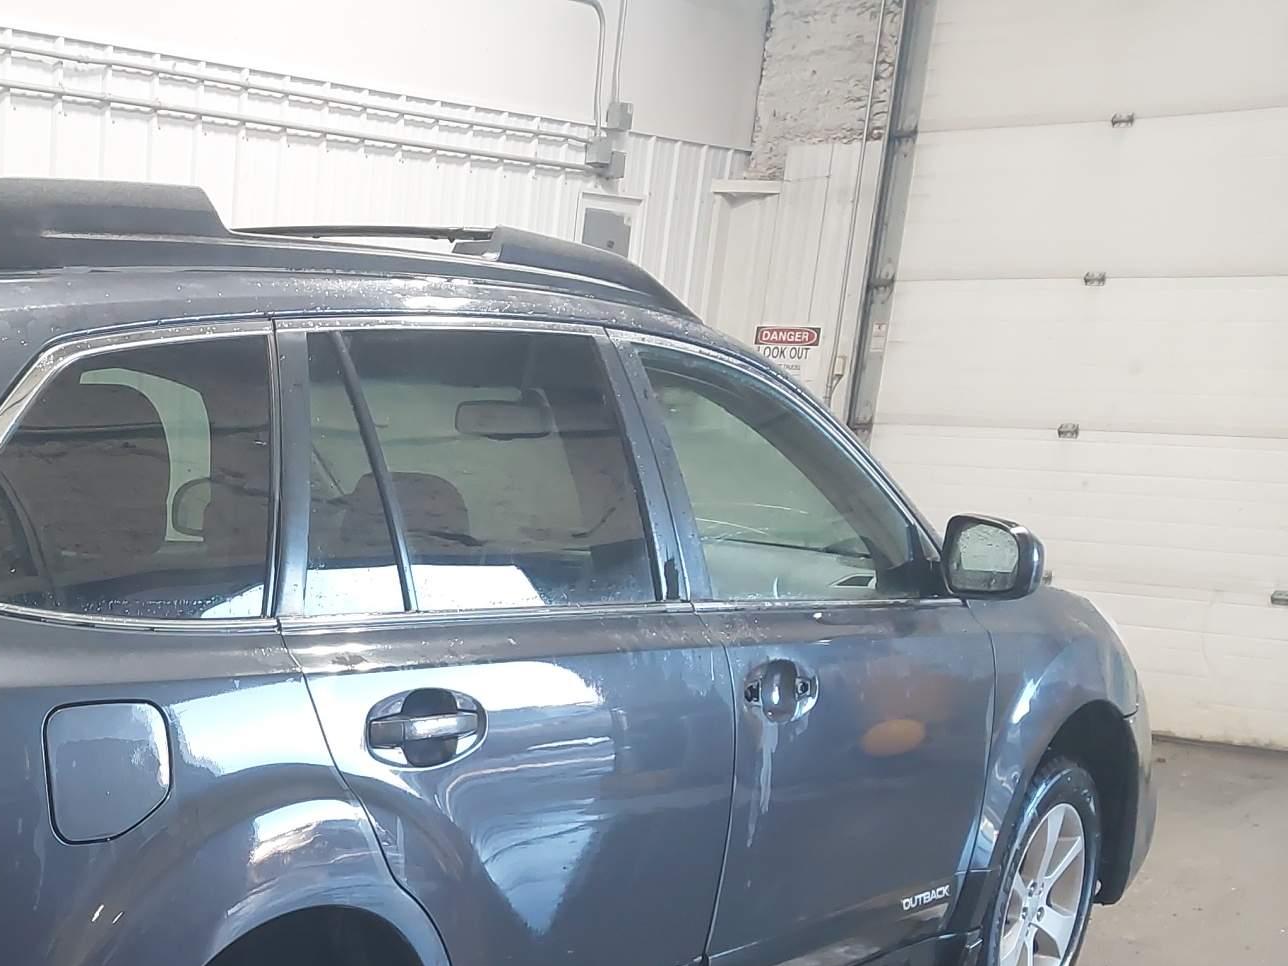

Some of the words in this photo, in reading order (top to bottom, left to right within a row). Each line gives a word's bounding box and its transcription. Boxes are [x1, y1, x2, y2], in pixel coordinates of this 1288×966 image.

[762, 331, 809, 341] DANGER
[789, 346, 810, 359] OUT
[902, 884, 951, 910] OUTBACK
